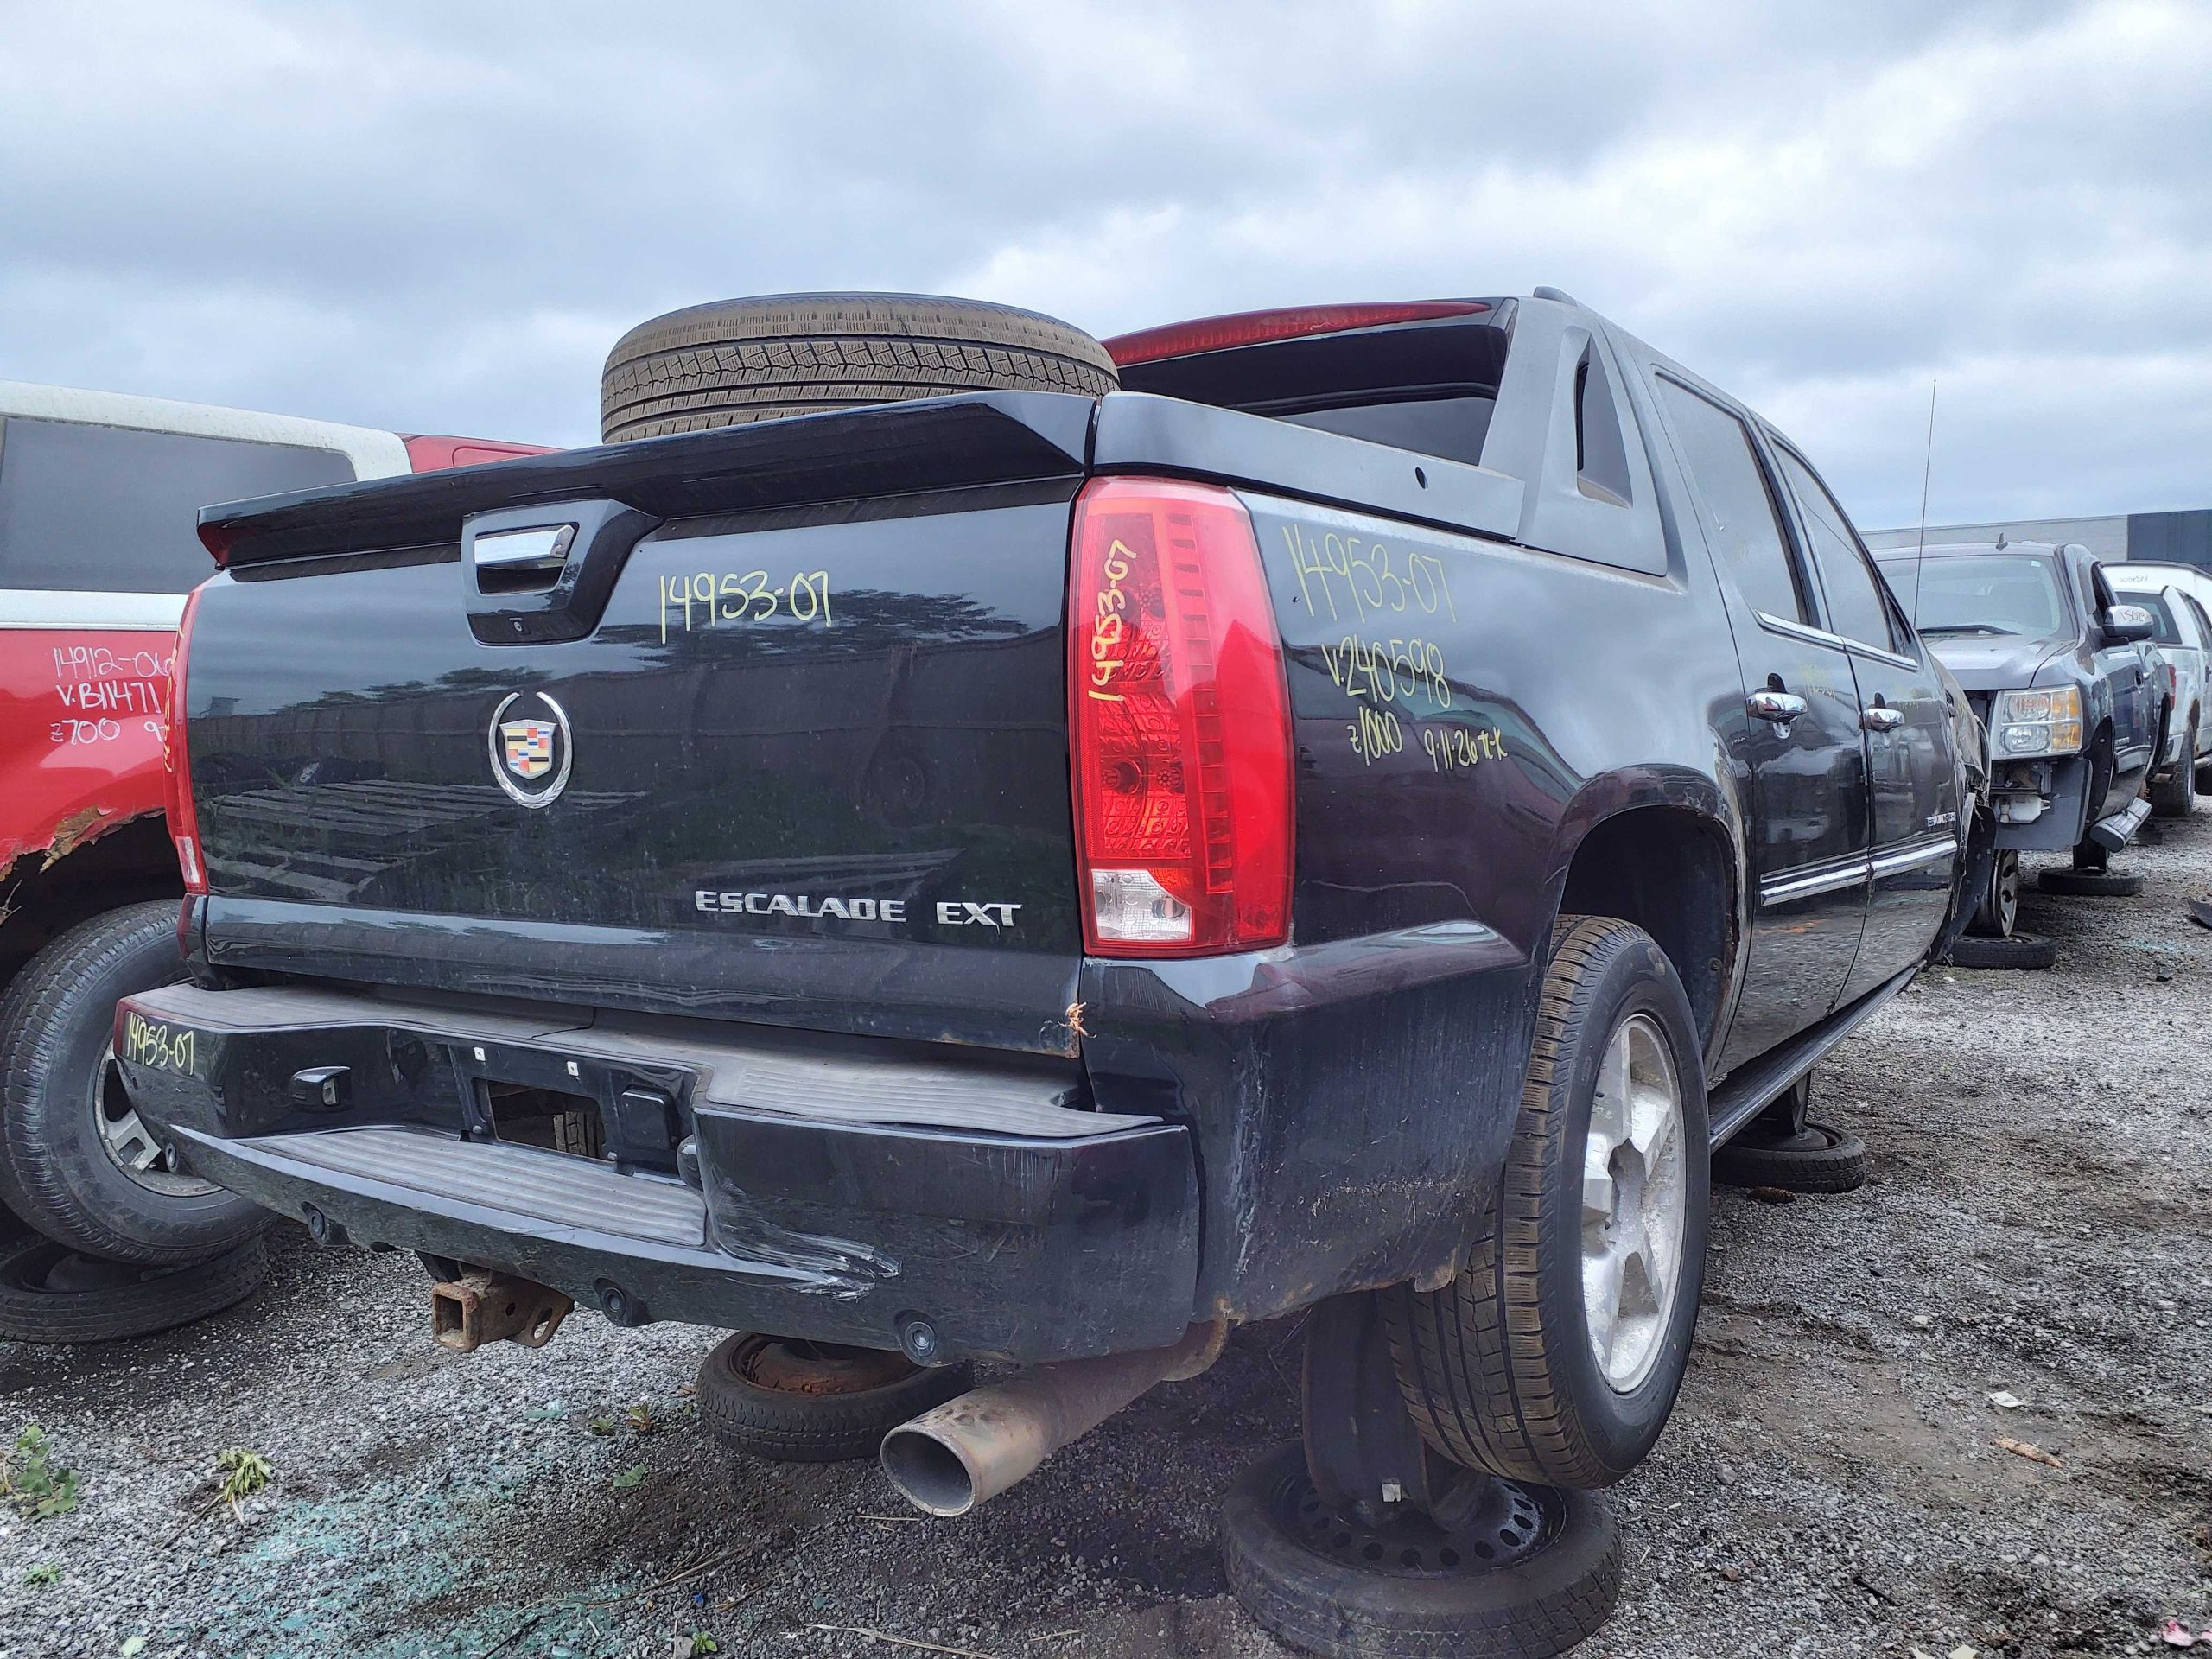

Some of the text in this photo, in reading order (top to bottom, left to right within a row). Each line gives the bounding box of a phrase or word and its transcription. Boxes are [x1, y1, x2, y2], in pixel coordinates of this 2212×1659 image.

[660, 570, 832, 645] 14953-07
[1282, 524, 1456, 622] 14953-07
[695, 890, 1023, 937] ESCALADE EXT
[126, 1011, 194, 1076] 14953-07
